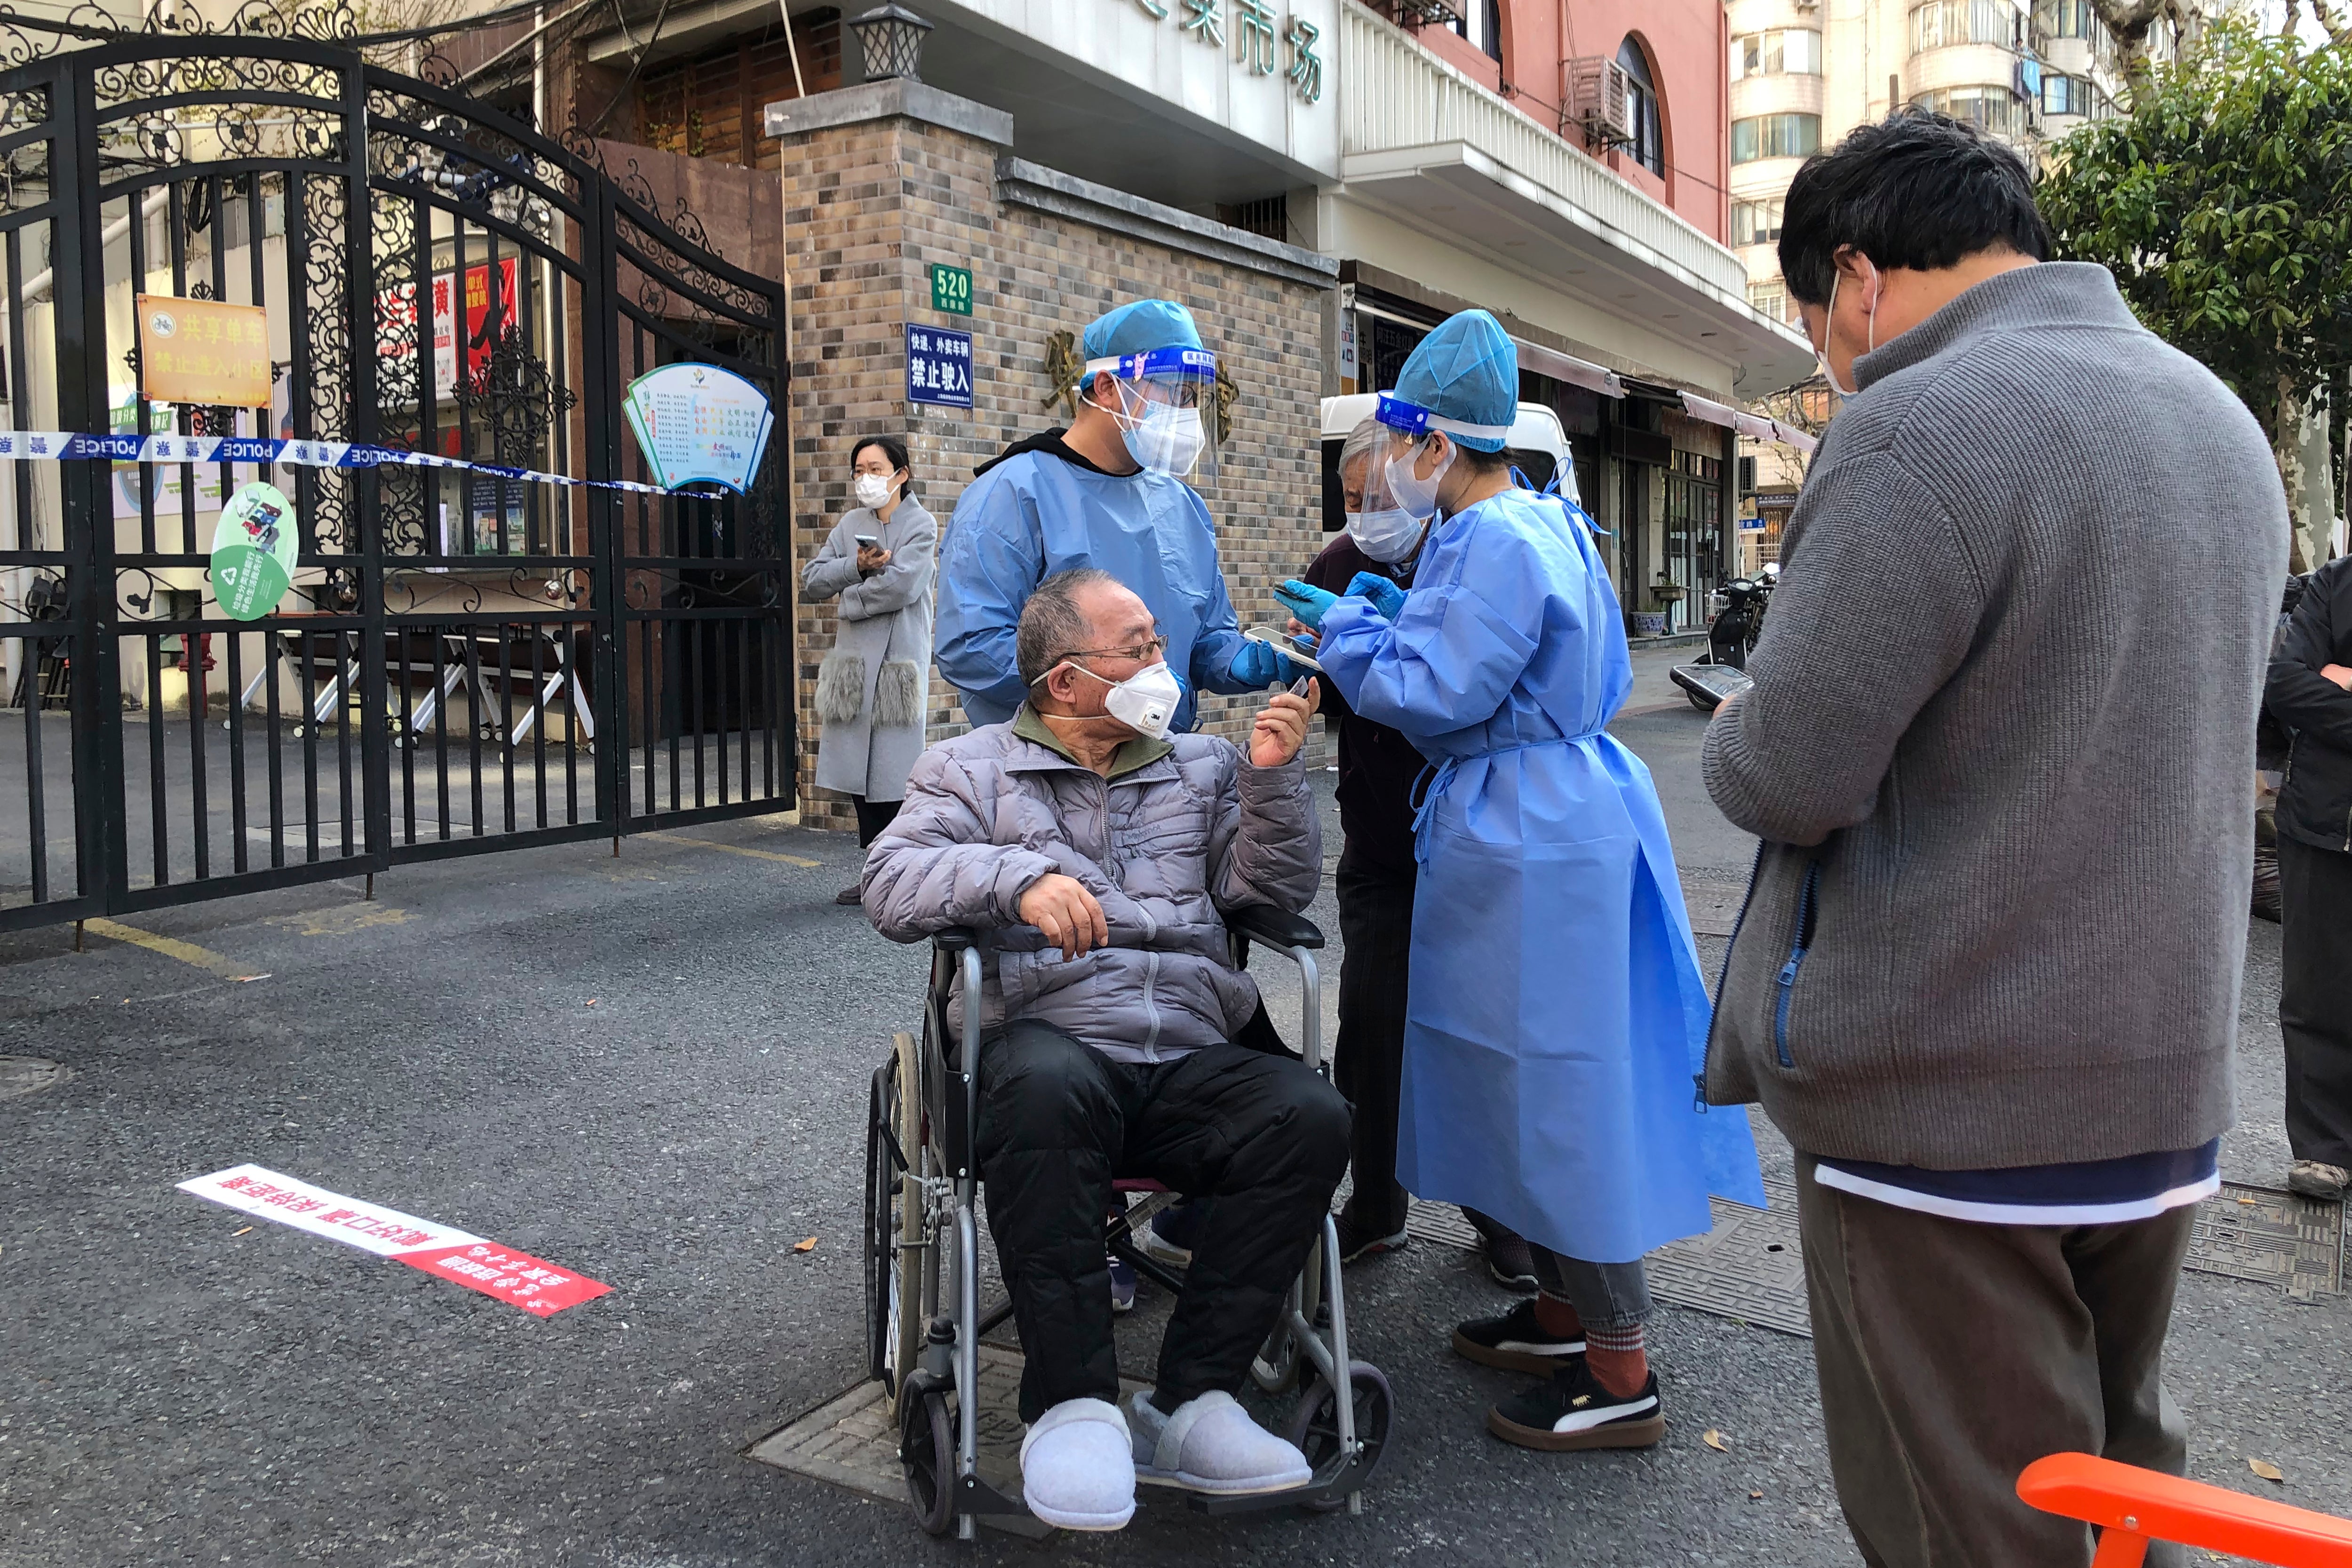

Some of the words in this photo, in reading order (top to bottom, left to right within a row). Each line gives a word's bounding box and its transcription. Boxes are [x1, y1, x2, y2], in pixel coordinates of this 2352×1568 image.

[1137, 0, 1320, 104] 菜市场
[938, 269, 967, 298] 520
[183, 314, 263, 347] 共享单车
[911, 333, 969, 358] 快递、外卖车辆
[154, 350, 266, 380] 禁止进入小区
[911, 357, 969, 393] 禁止驶入
[74, 439, 136, 455] POLICE
[223, 443, 273, 458] POLICE
[351, 449, 400, 462] POLICE
[217, 1176, 328, 1212] 保持距离
[317, 1209, 438, 1246] 戴好口罩
